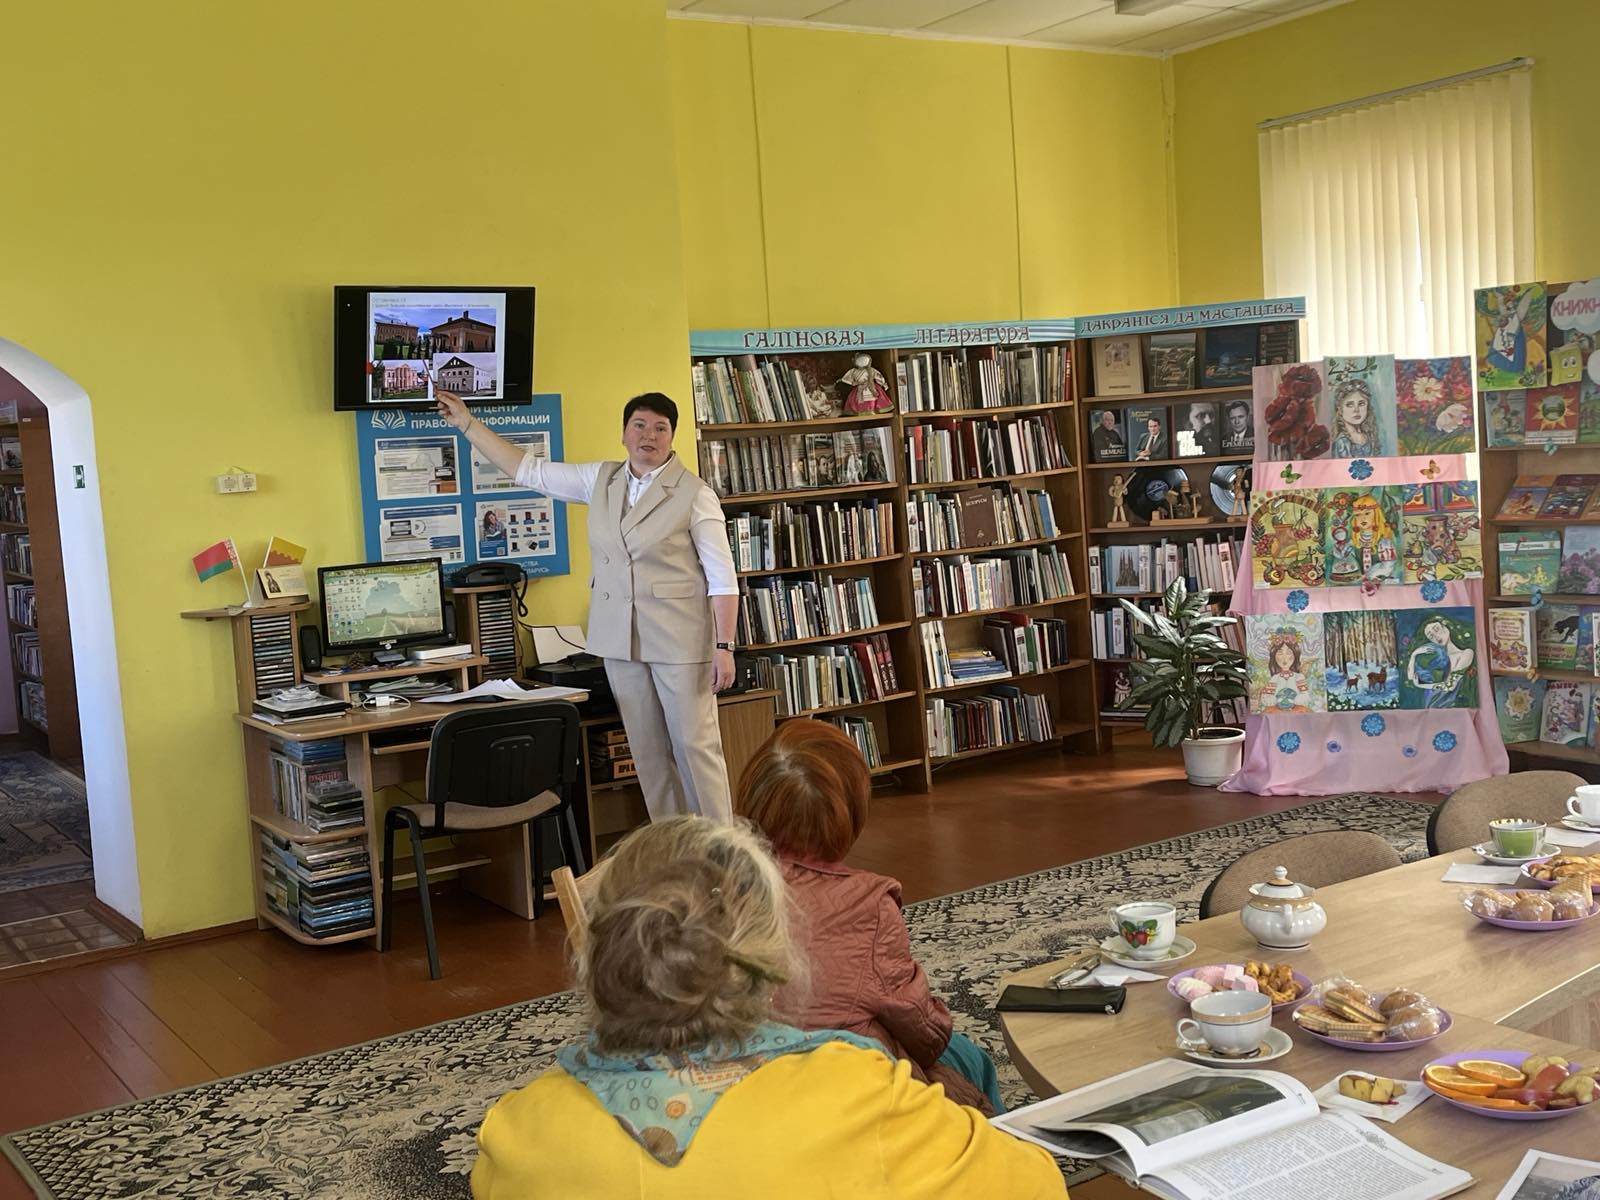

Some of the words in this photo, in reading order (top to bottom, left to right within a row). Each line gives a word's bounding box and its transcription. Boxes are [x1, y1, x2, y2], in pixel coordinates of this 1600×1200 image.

[1081, 313, 1169, 333] ДАКРАНІСЯ
[1174, 311, 1195, 326] ДА
[1199, 302, 1295, 321] МАСТАЦТВА
[743, 329, 865, 349] ГАЛІНОВАЯ
[912, 324, 1030, 347] ЛІТАРАТУРА
